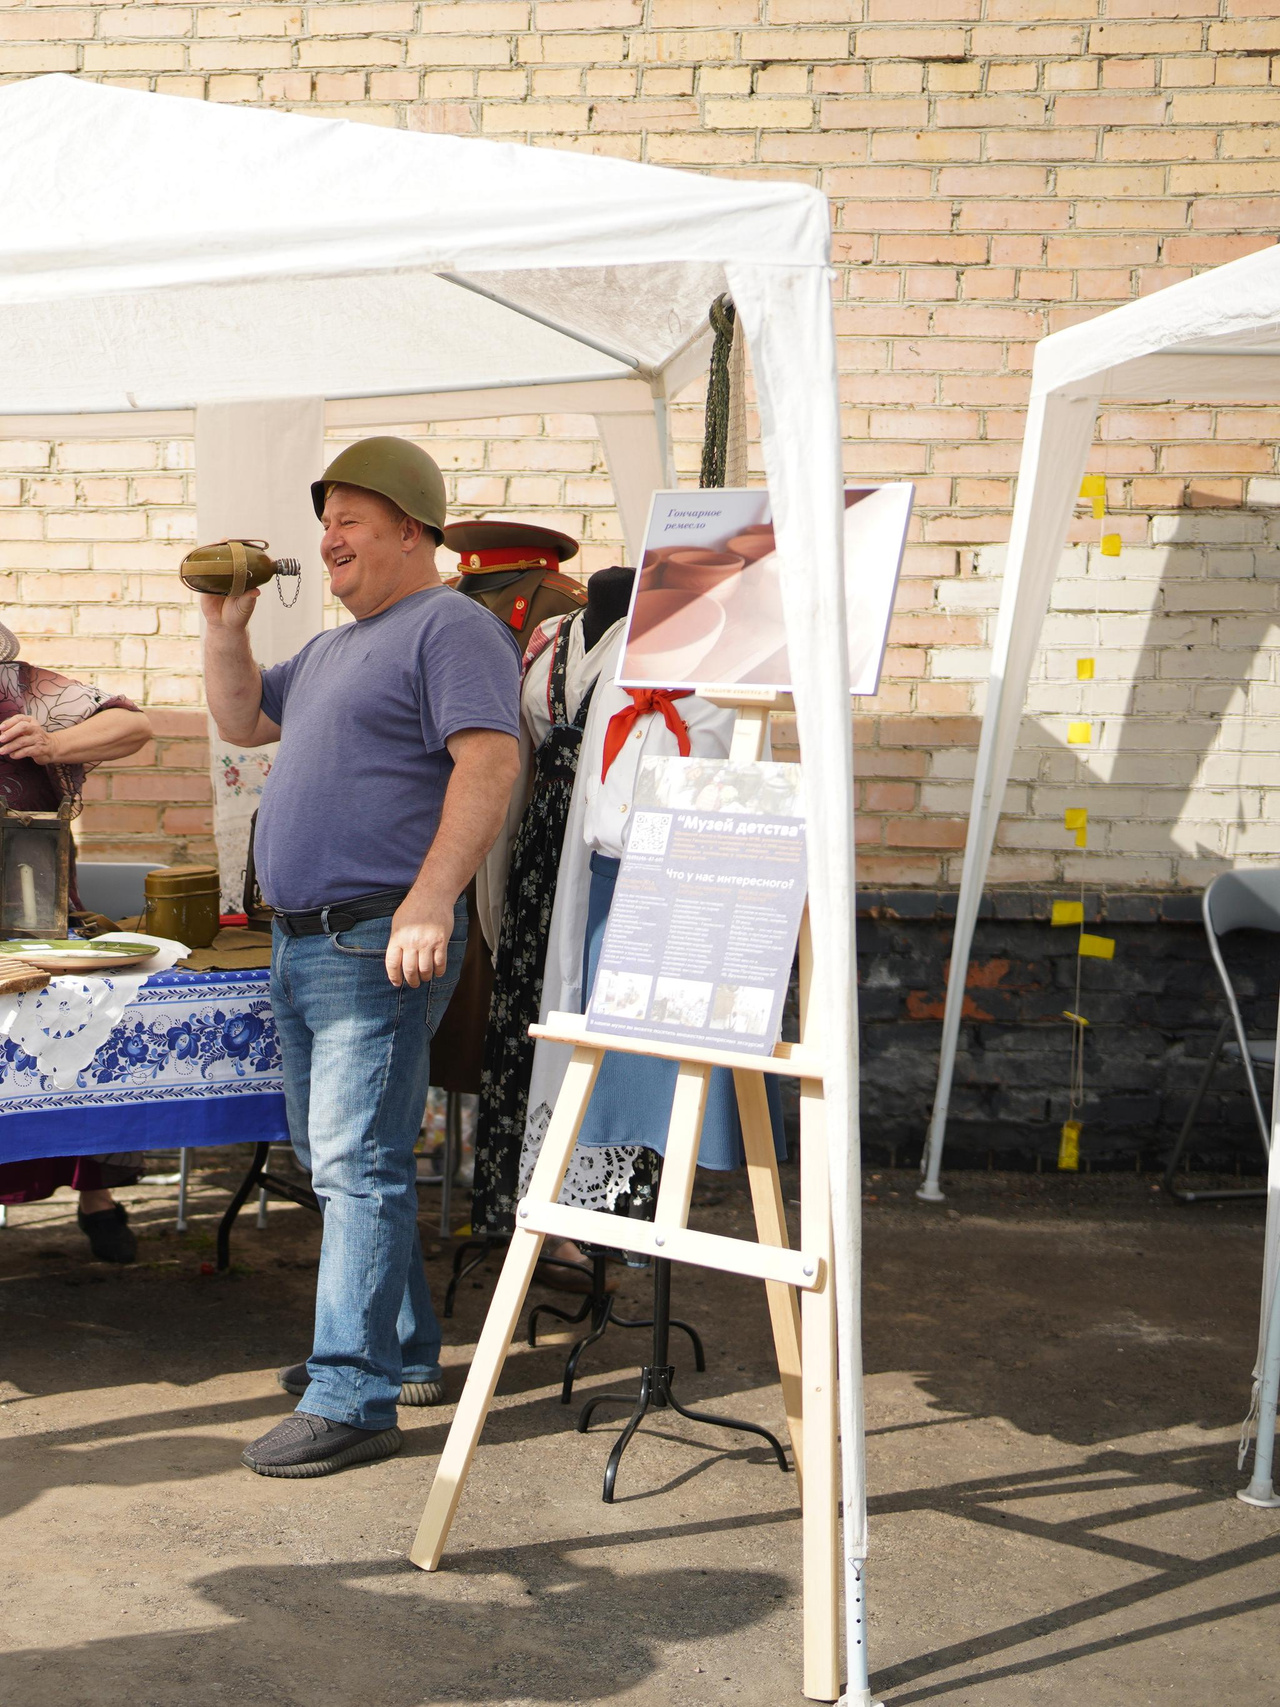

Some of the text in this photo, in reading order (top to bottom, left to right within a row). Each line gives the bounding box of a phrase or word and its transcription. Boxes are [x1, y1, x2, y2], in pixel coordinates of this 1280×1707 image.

[667, 509, 722, 518] Гончарное
[664, 522, 706, 531] ремесло
[666, 868, 795, 889] Что у нас интересного?
